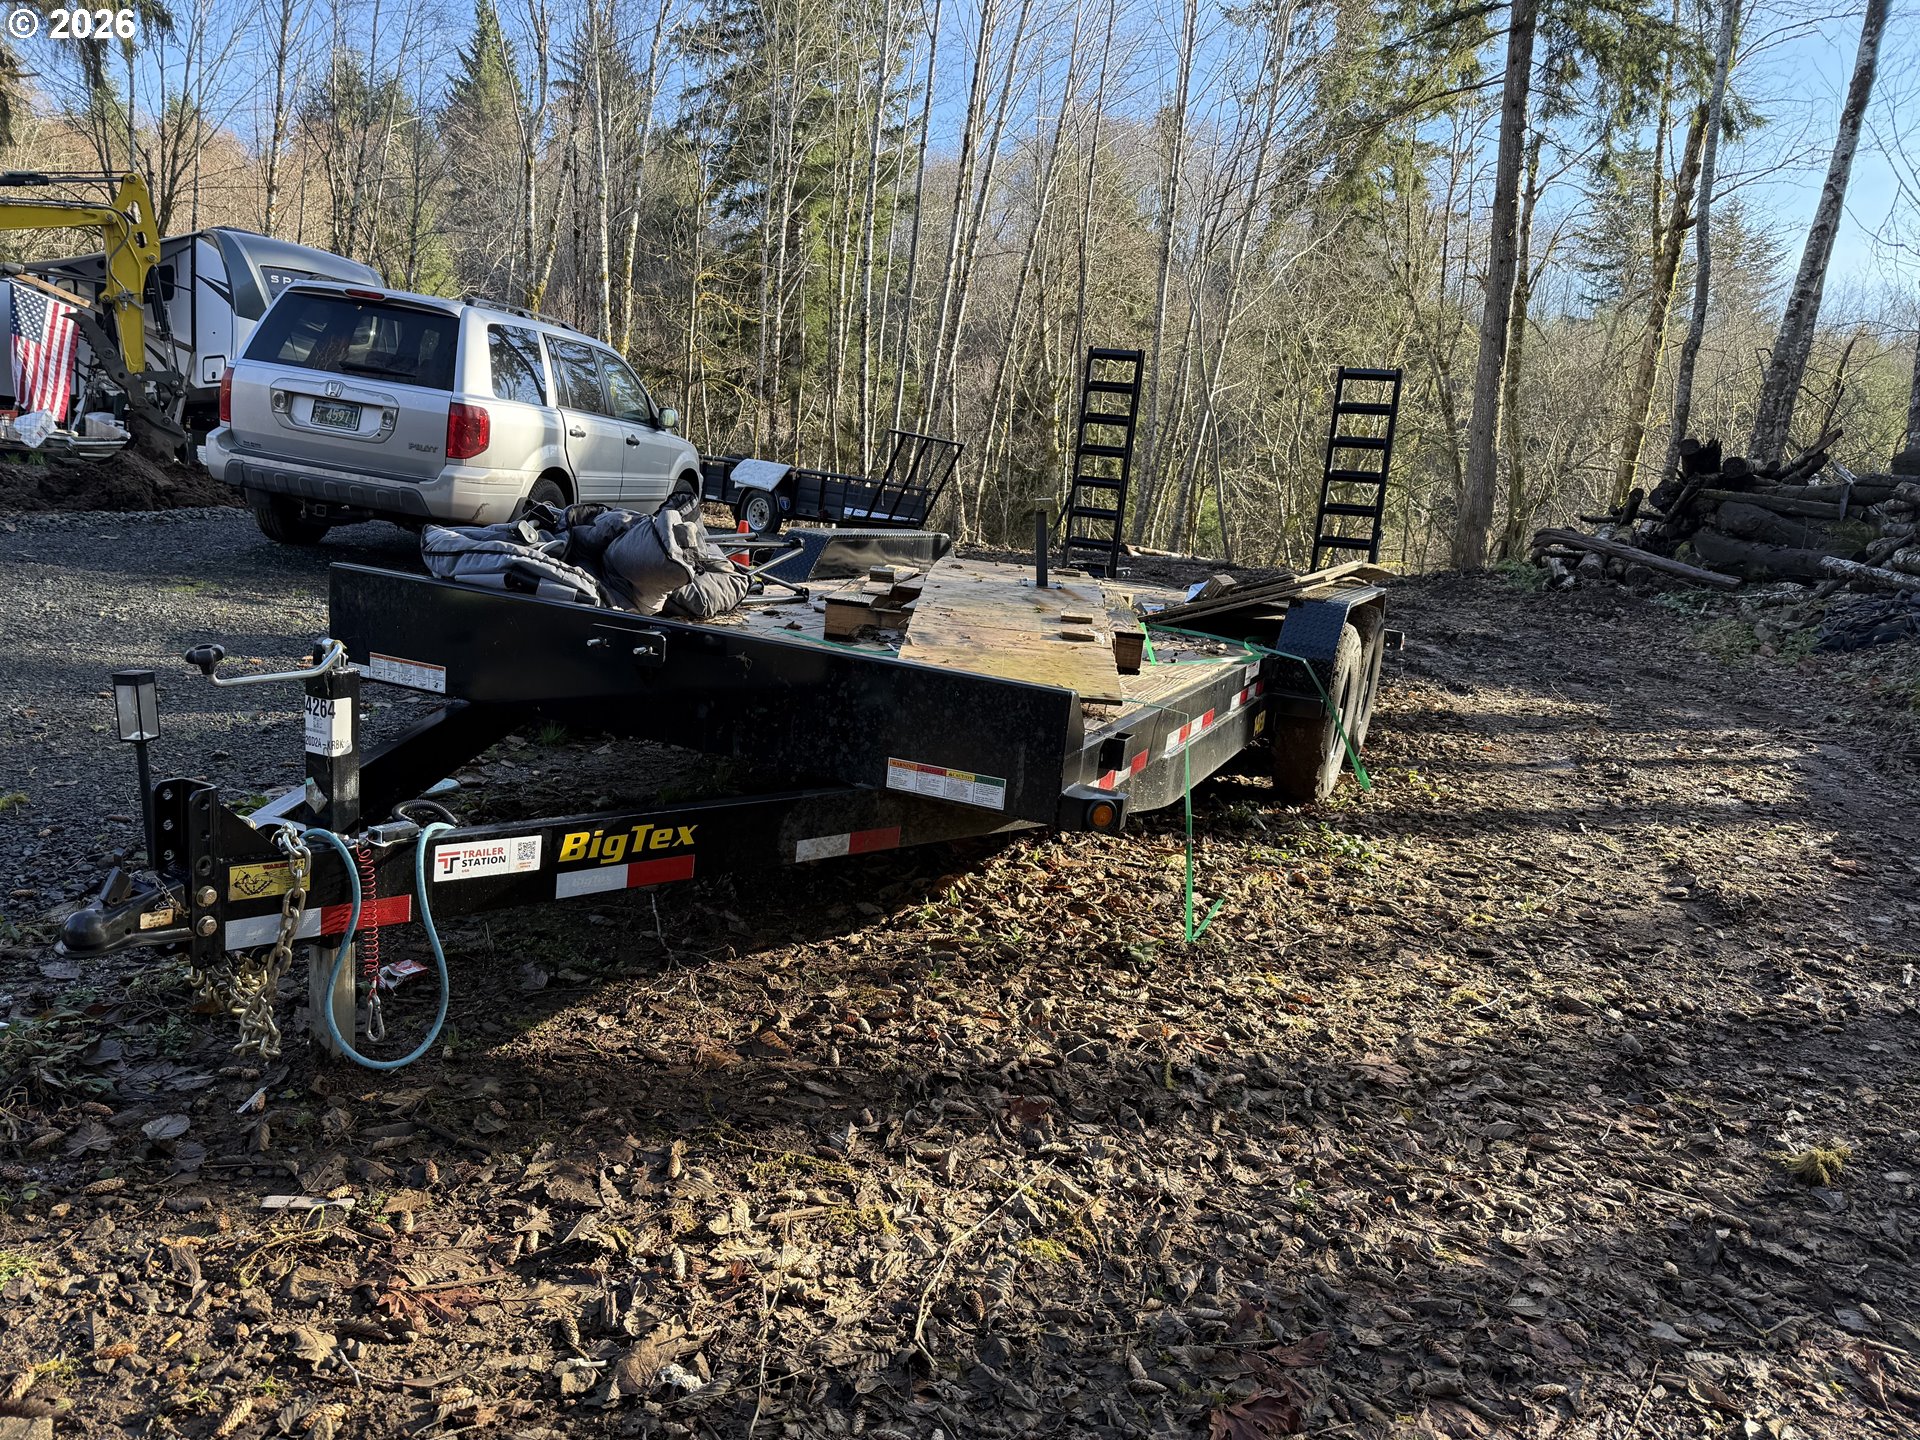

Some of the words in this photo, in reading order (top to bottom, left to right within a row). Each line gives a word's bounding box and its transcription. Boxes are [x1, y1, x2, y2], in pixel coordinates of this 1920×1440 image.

[305, 696, 336, 719] 4264
[462, 847, 504, 858] TRAILER
[558, 824, 698, 864] BigTex
[461, 855, 506, 868] STATION
